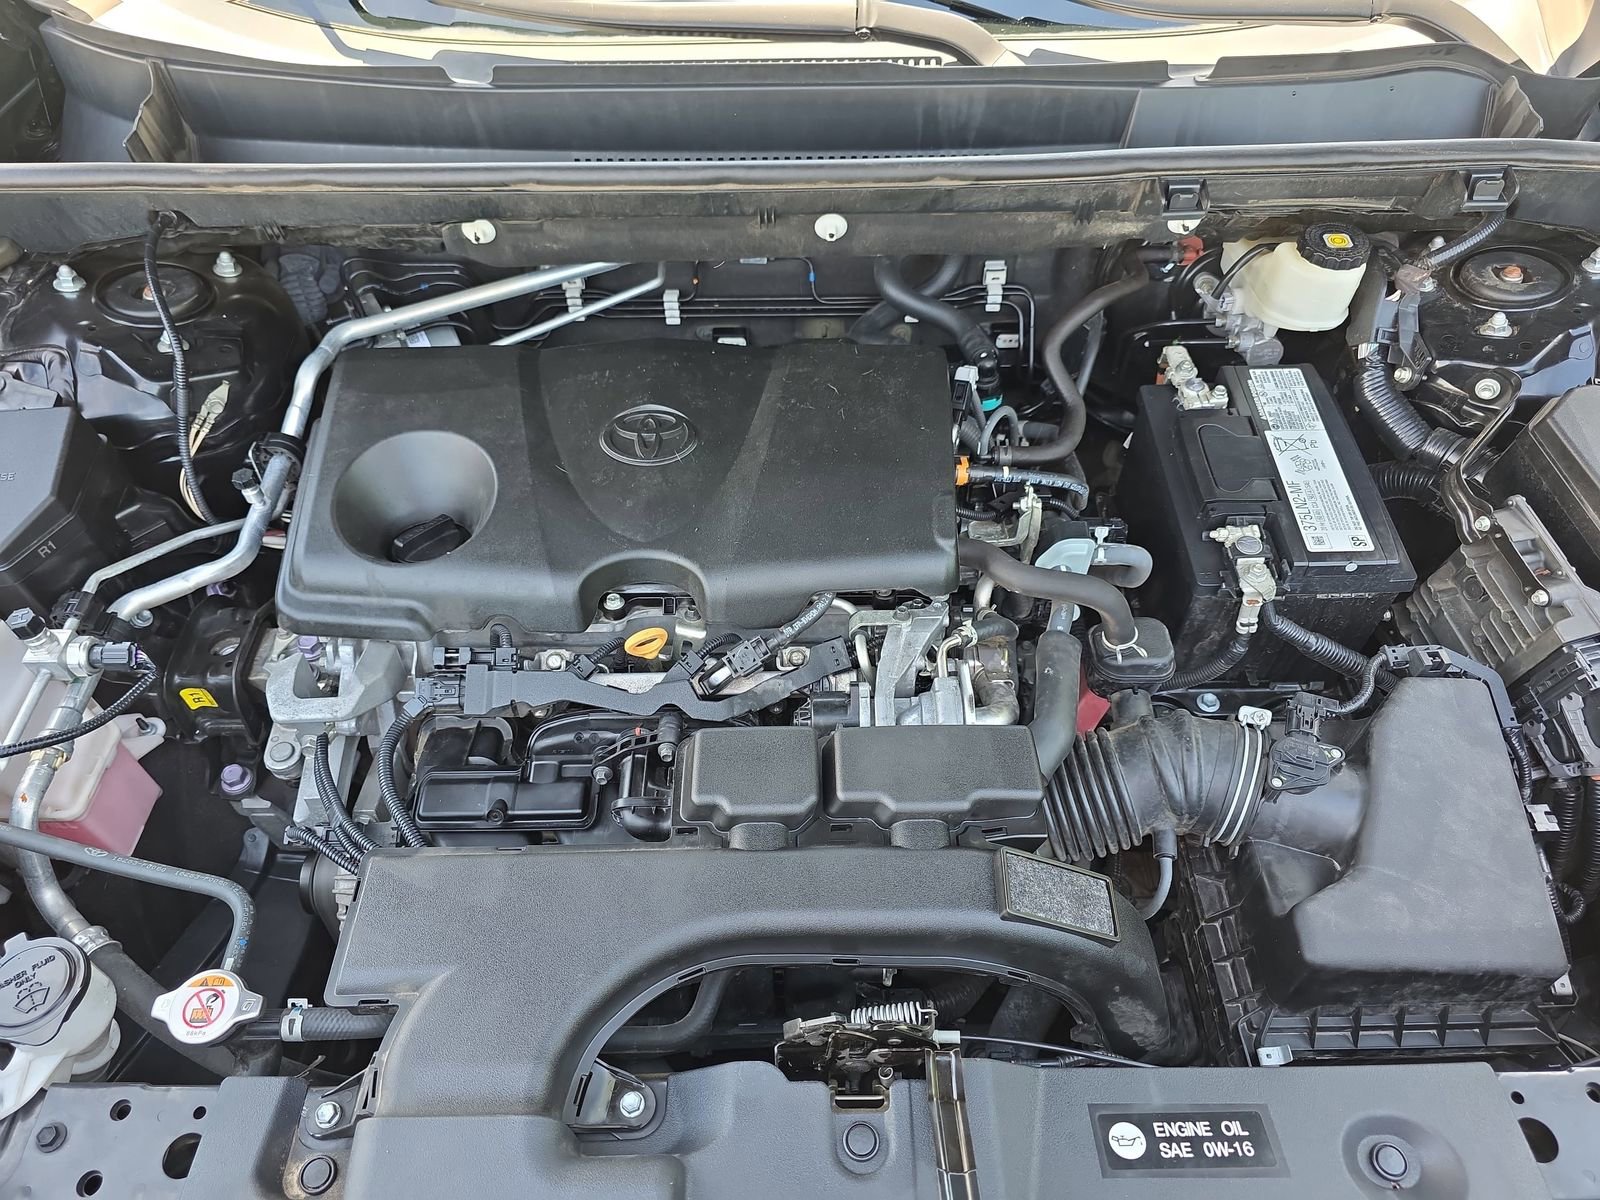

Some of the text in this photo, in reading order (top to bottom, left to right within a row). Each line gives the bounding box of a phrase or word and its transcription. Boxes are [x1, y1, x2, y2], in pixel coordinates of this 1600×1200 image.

[1309, 439, 1319, 449] Pb
[1286, 480, 1318, 532] 375LN2-MF
[37, 540, 57, 558] R1
[1351, 536, 1368, 547] SP
[188, 692, 206, 703] R1
[31, 955, 56, 971] FLUID
[15, 972, 37, 989] ONLY
[1152, 1120, 1250, 1137] ENGINE OIL
[1158, 1140, 1255, 1158] SAE 0W-16
